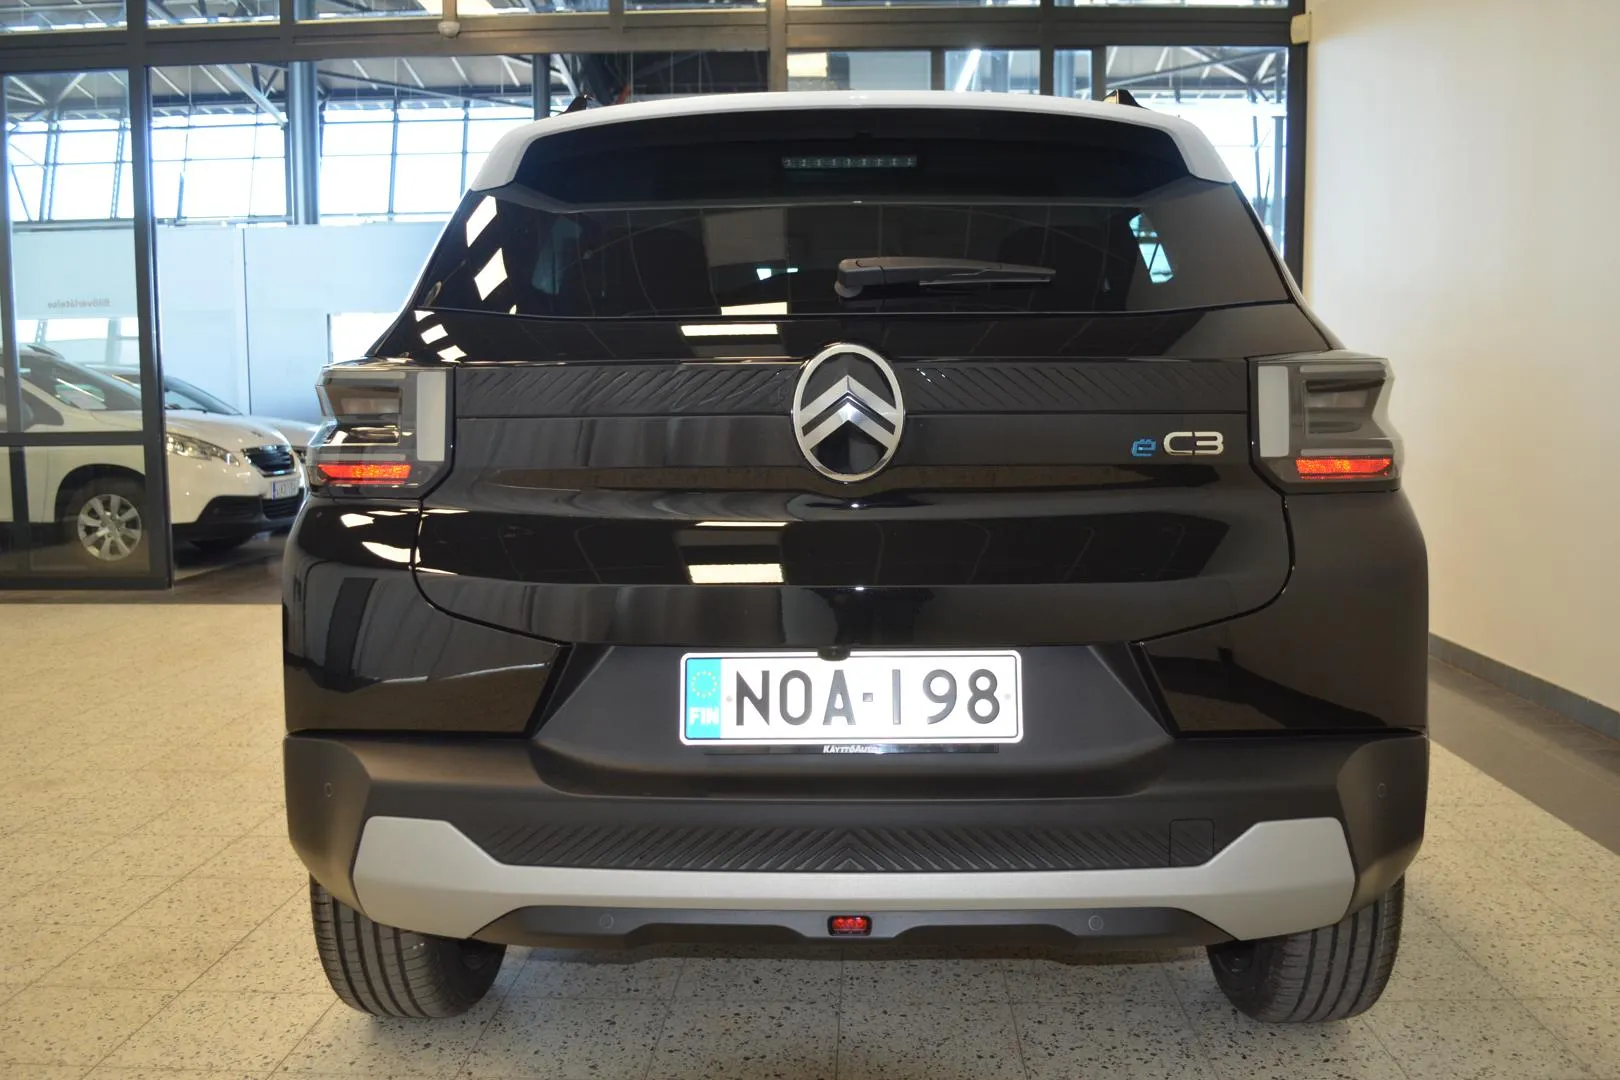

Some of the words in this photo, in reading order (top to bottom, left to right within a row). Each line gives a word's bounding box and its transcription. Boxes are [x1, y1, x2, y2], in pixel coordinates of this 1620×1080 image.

[1163, 431, 1224, 456] C3
[735, 668, 1000, 726] NOA-198
[689, 707, 720, 725] FIN
